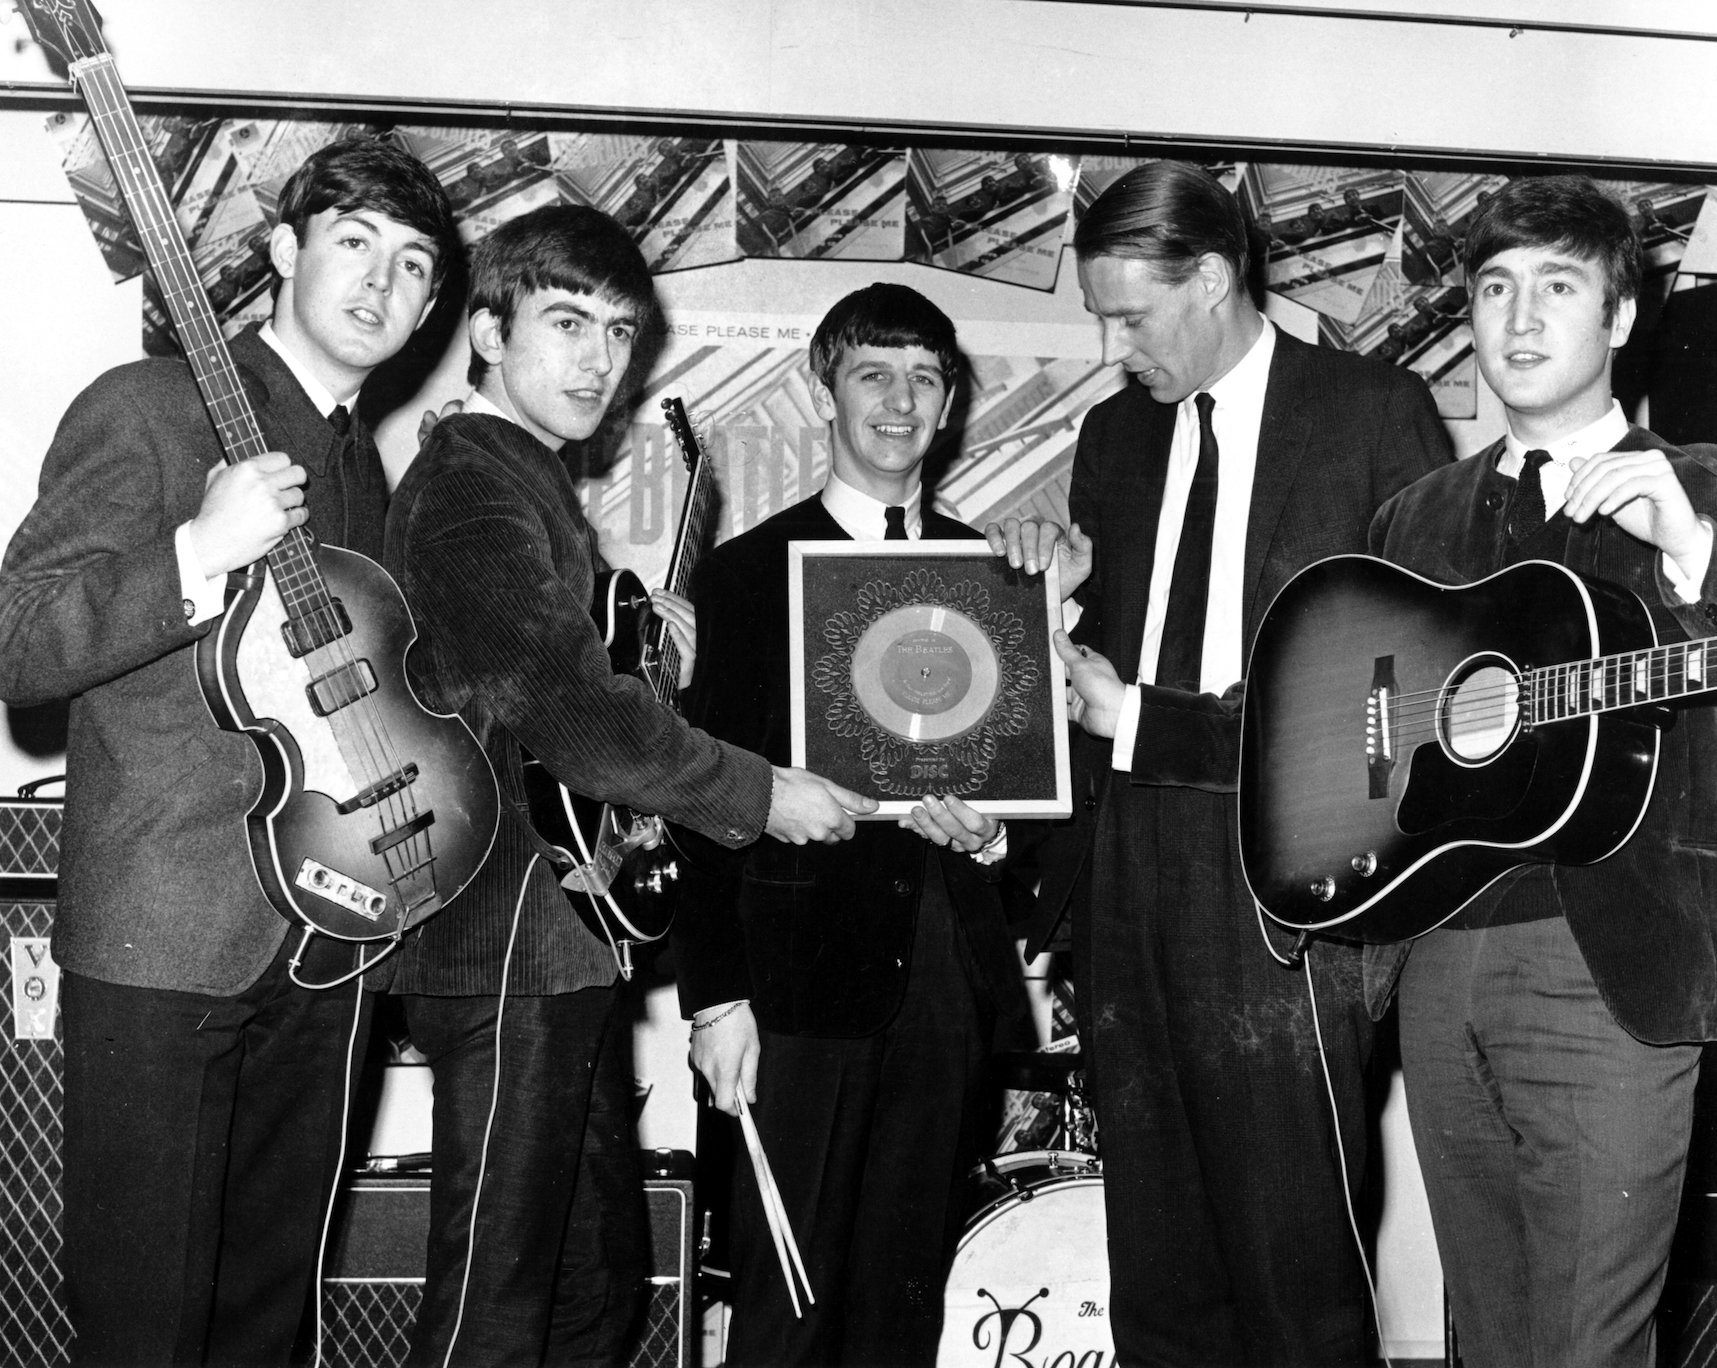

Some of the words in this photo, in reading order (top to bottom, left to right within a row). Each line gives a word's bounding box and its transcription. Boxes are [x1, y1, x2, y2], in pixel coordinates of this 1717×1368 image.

[881, 219, 900, 228] ME
[1036, 247, 1056, 259] ME
[706, 325, 770, 339] PLEASE
[777, 328, 800, 339] ME
[910, 764, 949, 779] DISC
[1044, 1040, 1071, 1052] tereo
[1078, 1301, 1104, 1317] The
